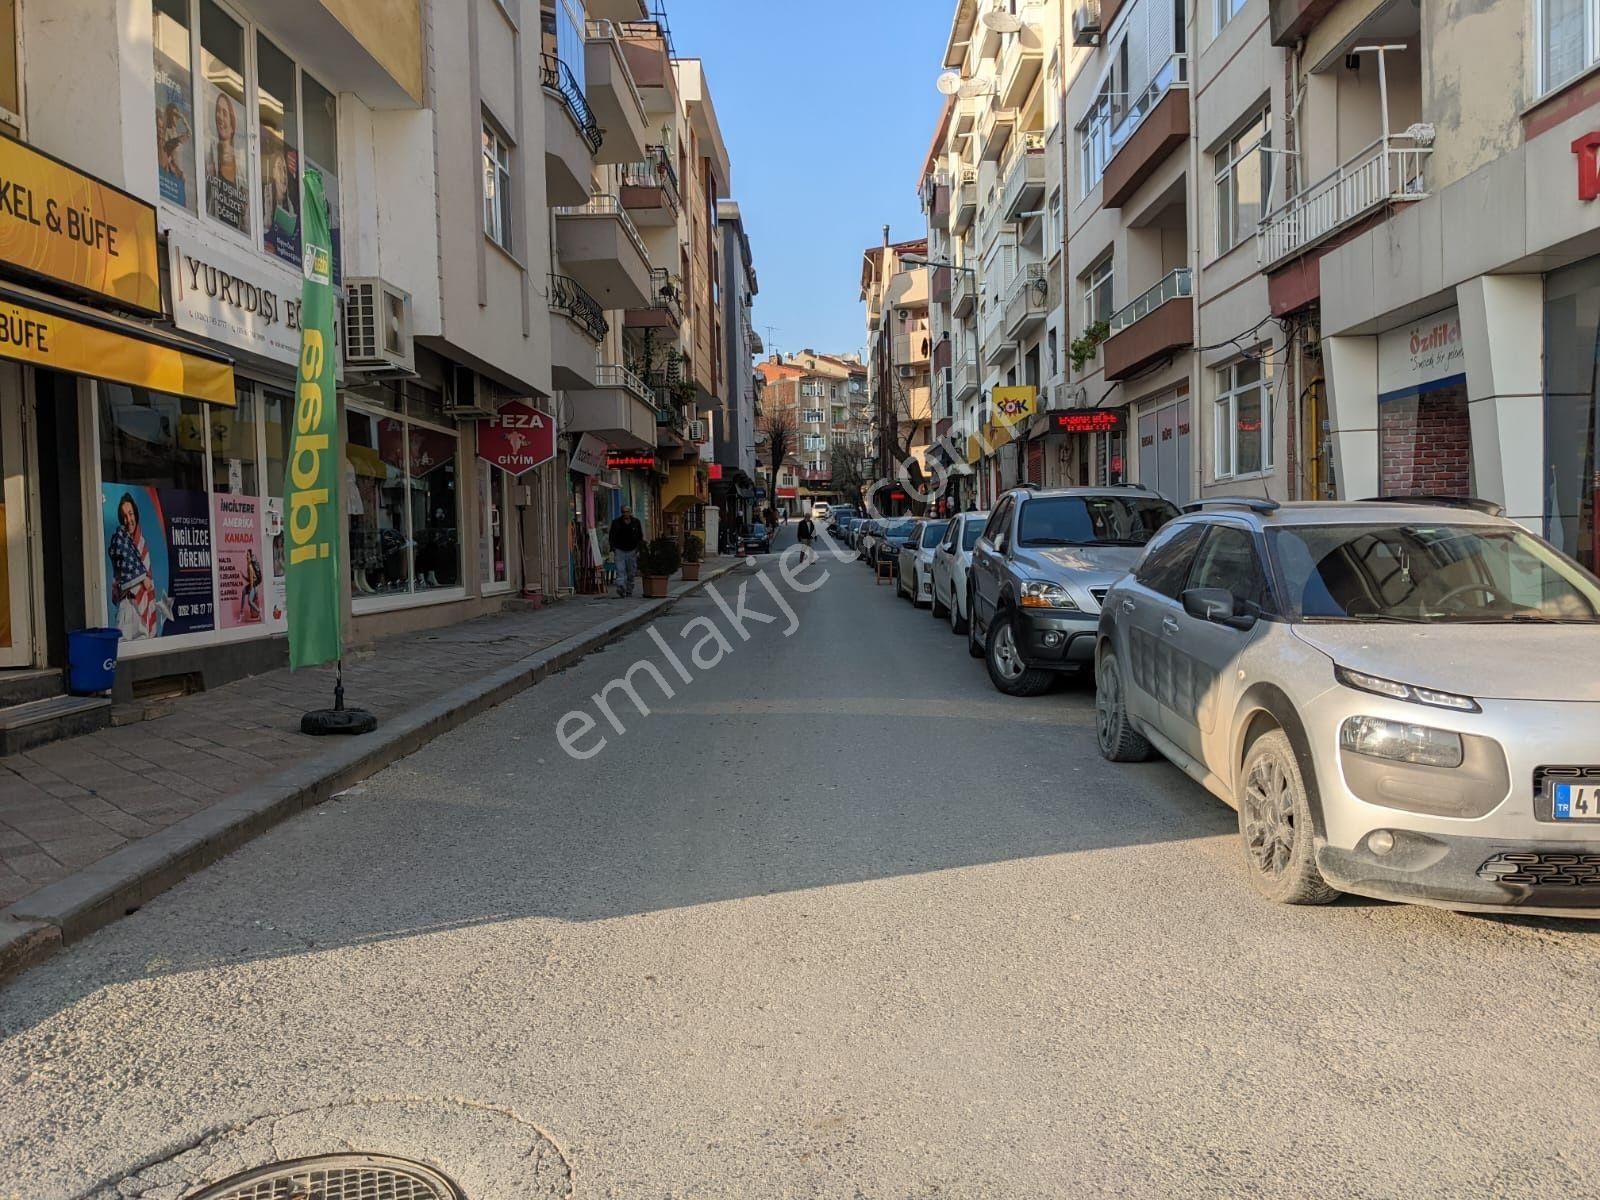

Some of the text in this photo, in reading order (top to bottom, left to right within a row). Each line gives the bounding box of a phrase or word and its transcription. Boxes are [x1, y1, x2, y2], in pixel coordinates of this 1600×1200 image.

[45, 198, 63, 235] &
[67, 205, 120, 257] BÜFE
[184, 255, 279, 327] YURTDIŞI
[0, 310, 49, 353] BÜFE
[489, 414, 545, 429] FEZA
[497, 453, 535, 465] GİYİM
[221, 499, 255, 513] İNGİLTERE
[223, 517, 253, 528] AMERİKA
[172, 526, 209, 546] İNGİLİZCE
[224, 534, 254, 544] KANADA
[178, 549, 211, 568] ÖĞRENİN
[1557, 803, 1569, 812] TR
[1575, 788, 1600, 815] 41
